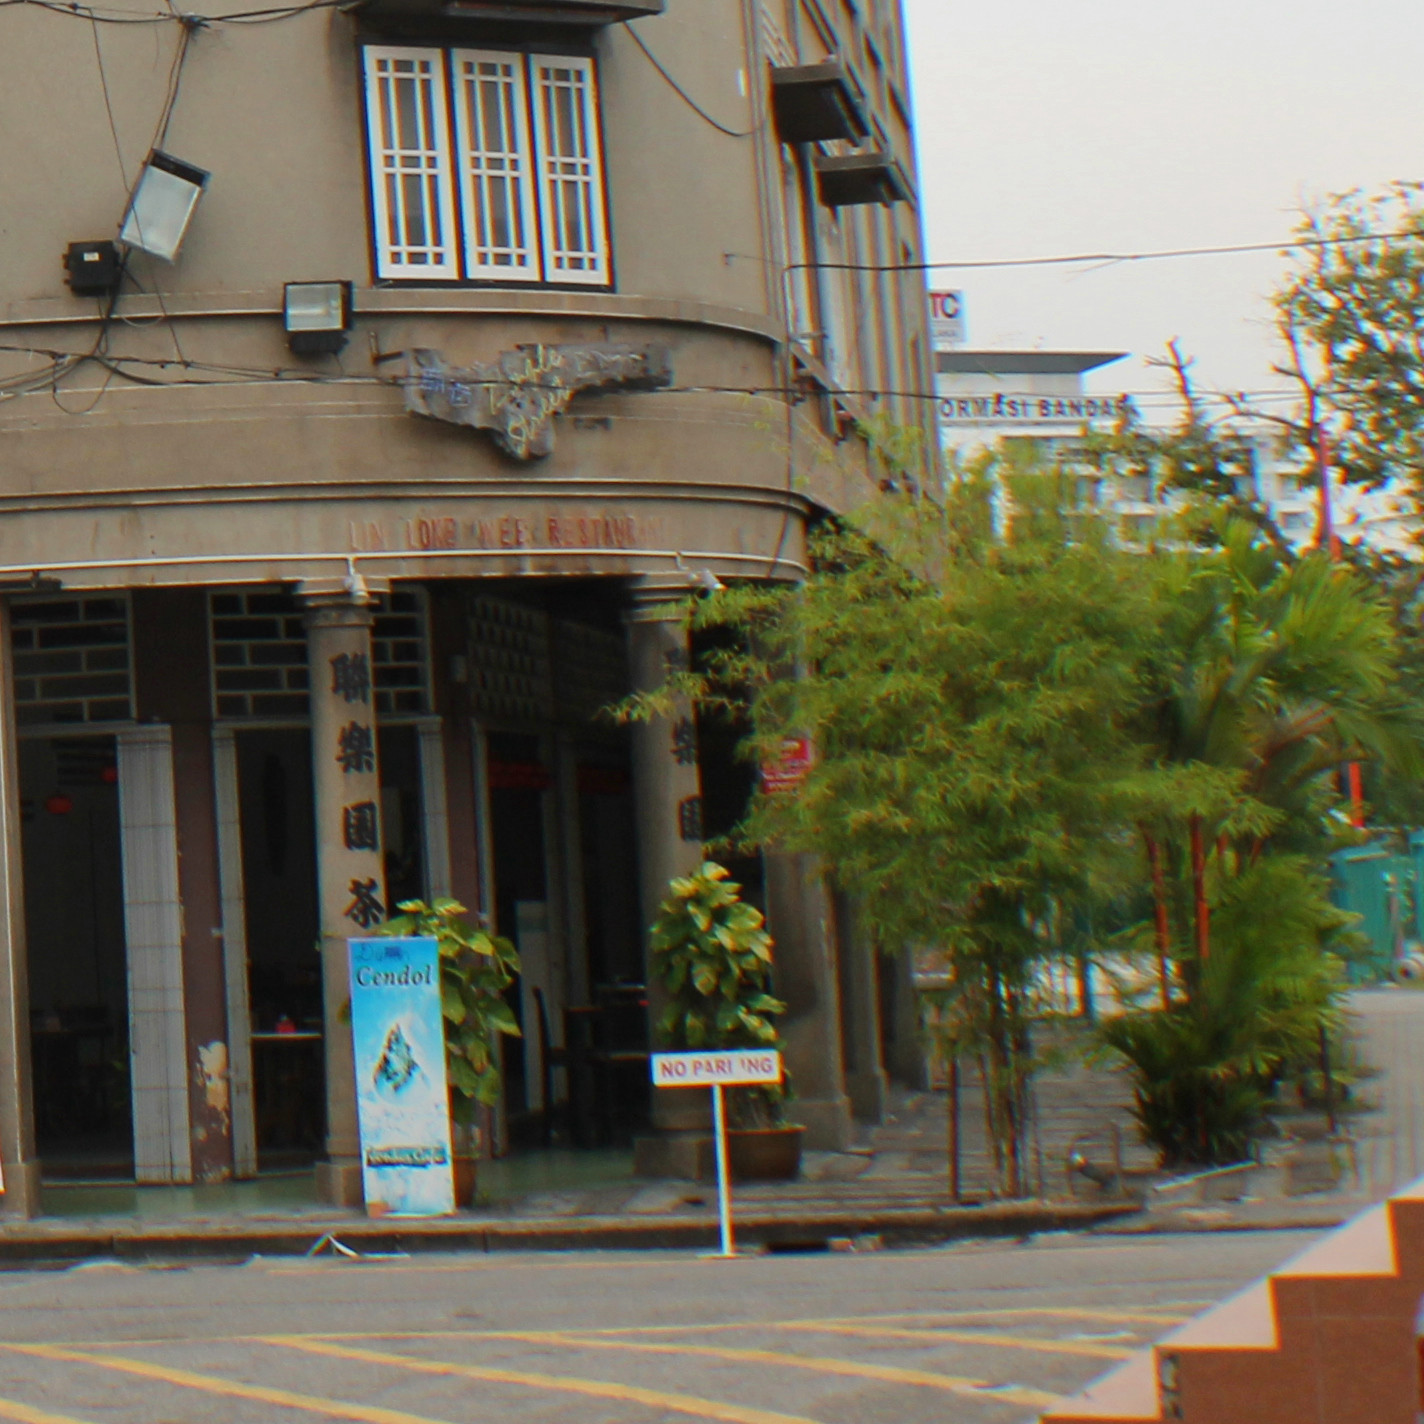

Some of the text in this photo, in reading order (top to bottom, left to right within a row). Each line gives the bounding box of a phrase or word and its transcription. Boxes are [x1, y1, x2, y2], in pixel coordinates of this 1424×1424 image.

[929, 292, 960, 319] TC
[939, 397, 1029, 417] ORMASI
[357, 965, 432, 987] Cendol
[661, 1057, 774, 1077] NO PARNG
